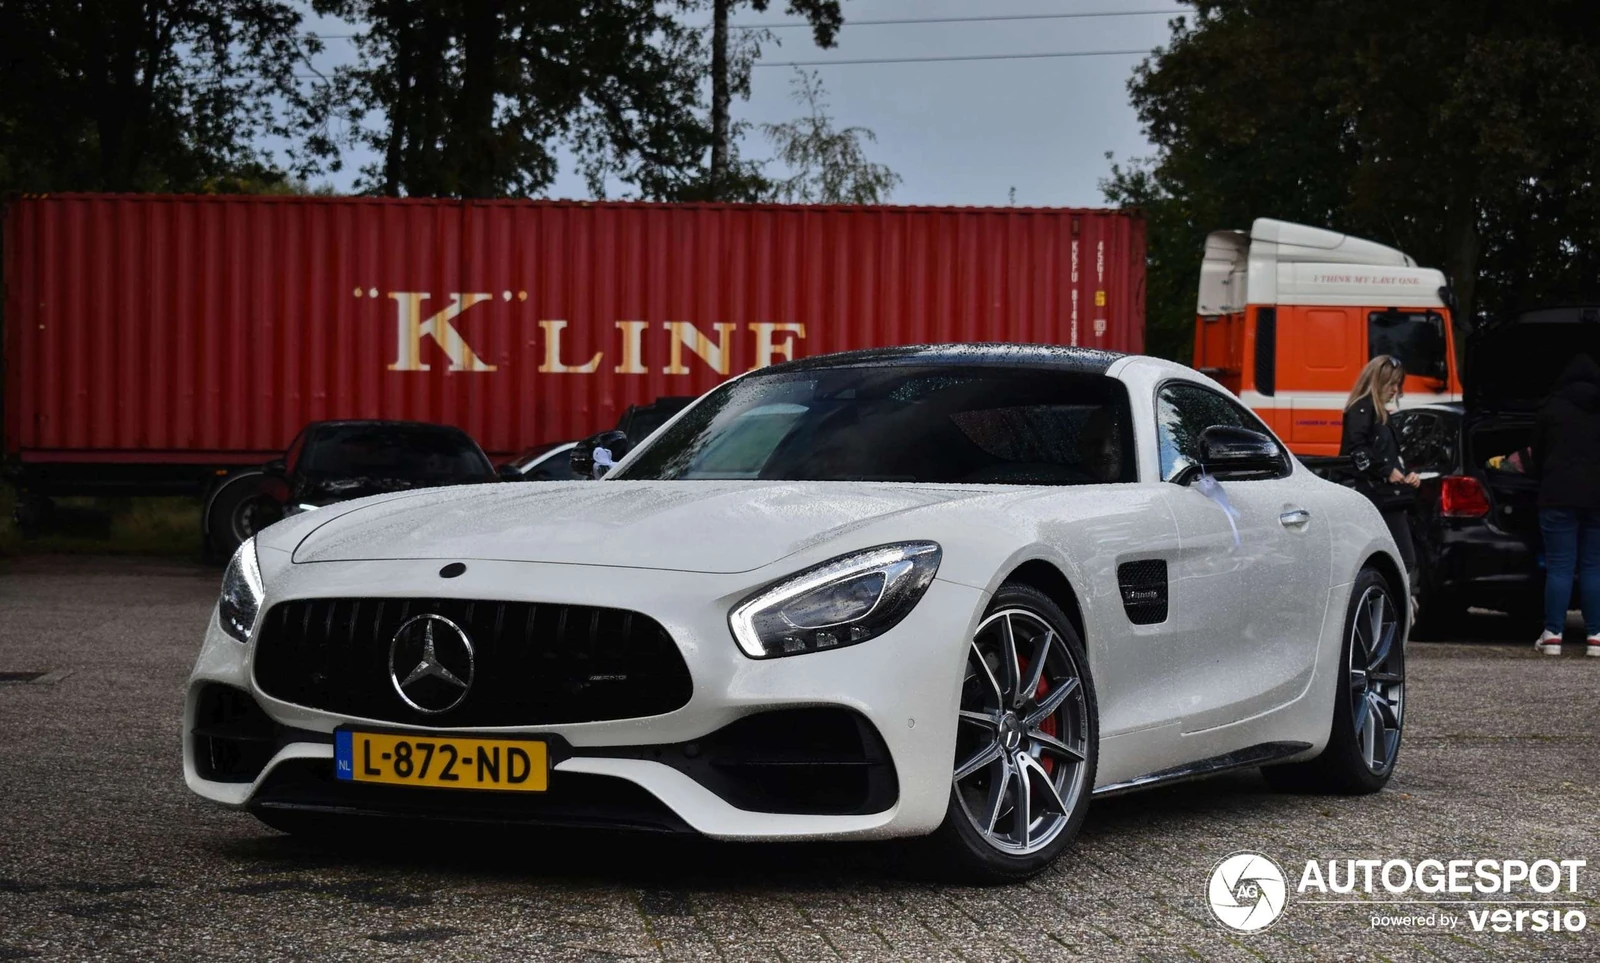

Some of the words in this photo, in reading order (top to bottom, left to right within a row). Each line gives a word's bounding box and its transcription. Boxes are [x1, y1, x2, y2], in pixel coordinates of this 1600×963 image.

[1320, 274, 1351, 284] THINK
[1354, 275, 1369, 284] MY
[1371, 275, 1396, 285] LAST
[538, 320, 807, 375] LINE
[339, 759, 351, 771] NL
[364, 739, 531, 784] L-872-ND
